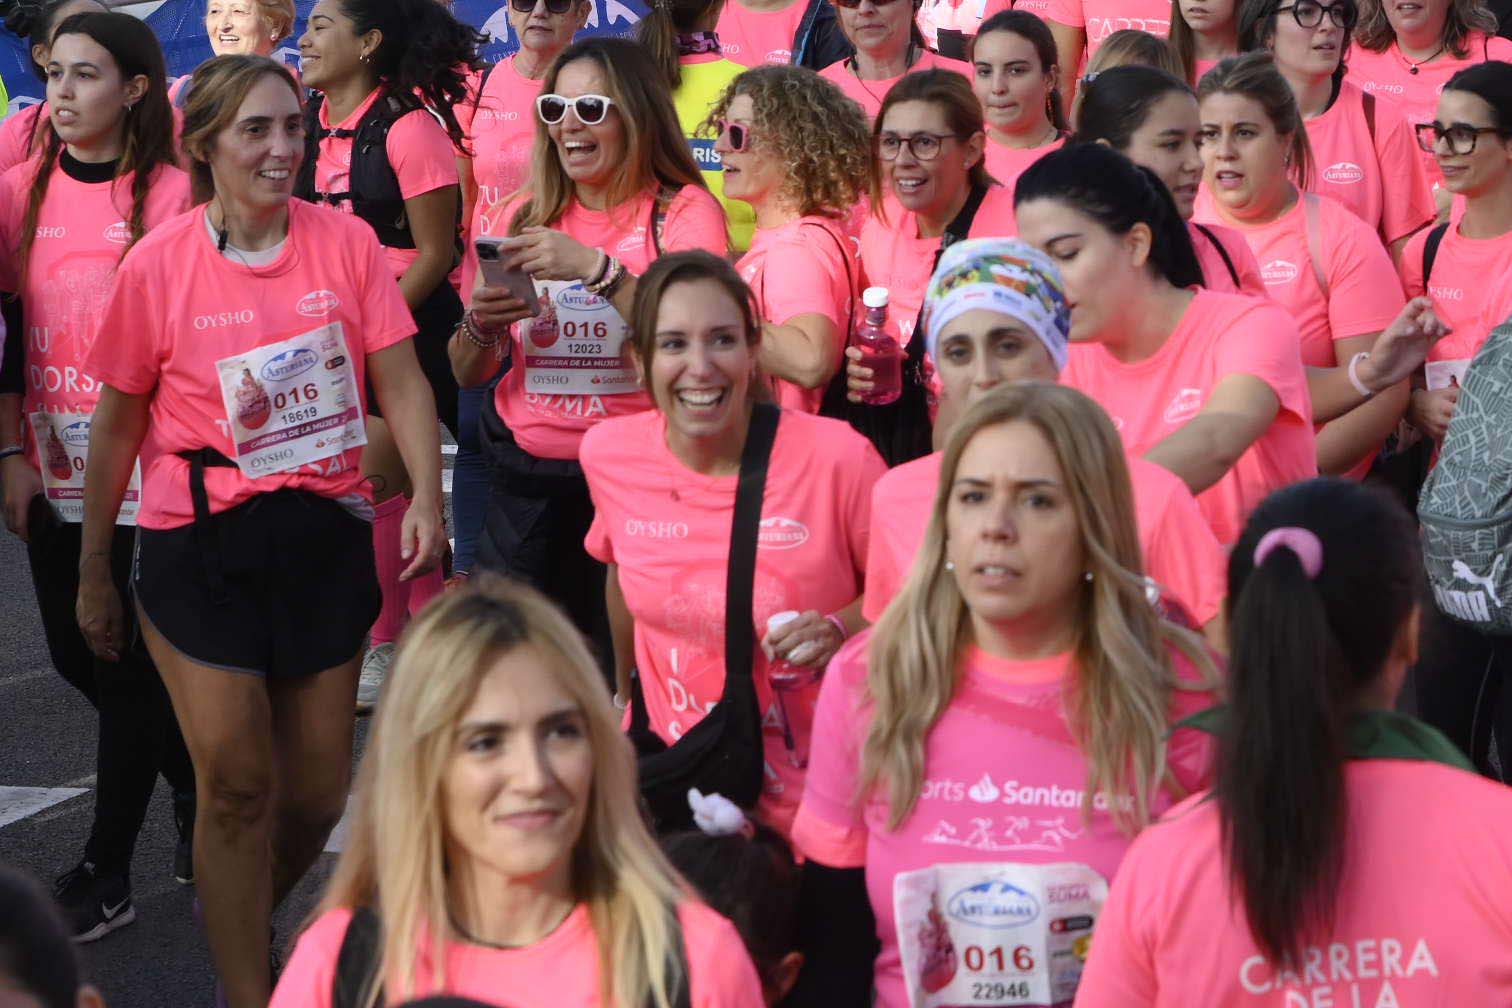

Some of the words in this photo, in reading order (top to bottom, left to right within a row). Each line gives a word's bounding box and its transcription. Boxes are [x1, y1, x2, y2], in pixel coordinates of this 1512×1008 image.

[193, 309, 254, 330] OYSHO
[563, 320, 608, 339] 016
[567, 343, 603, 355] 12023
[273, 382, 320, 410] 016
[250, 448, 295, 469] OYSHO
[625, 519, 690, 539] OYSHO
[963, 944, 1036, 972] 016
[972, 980, 1031, 1001] 22946
